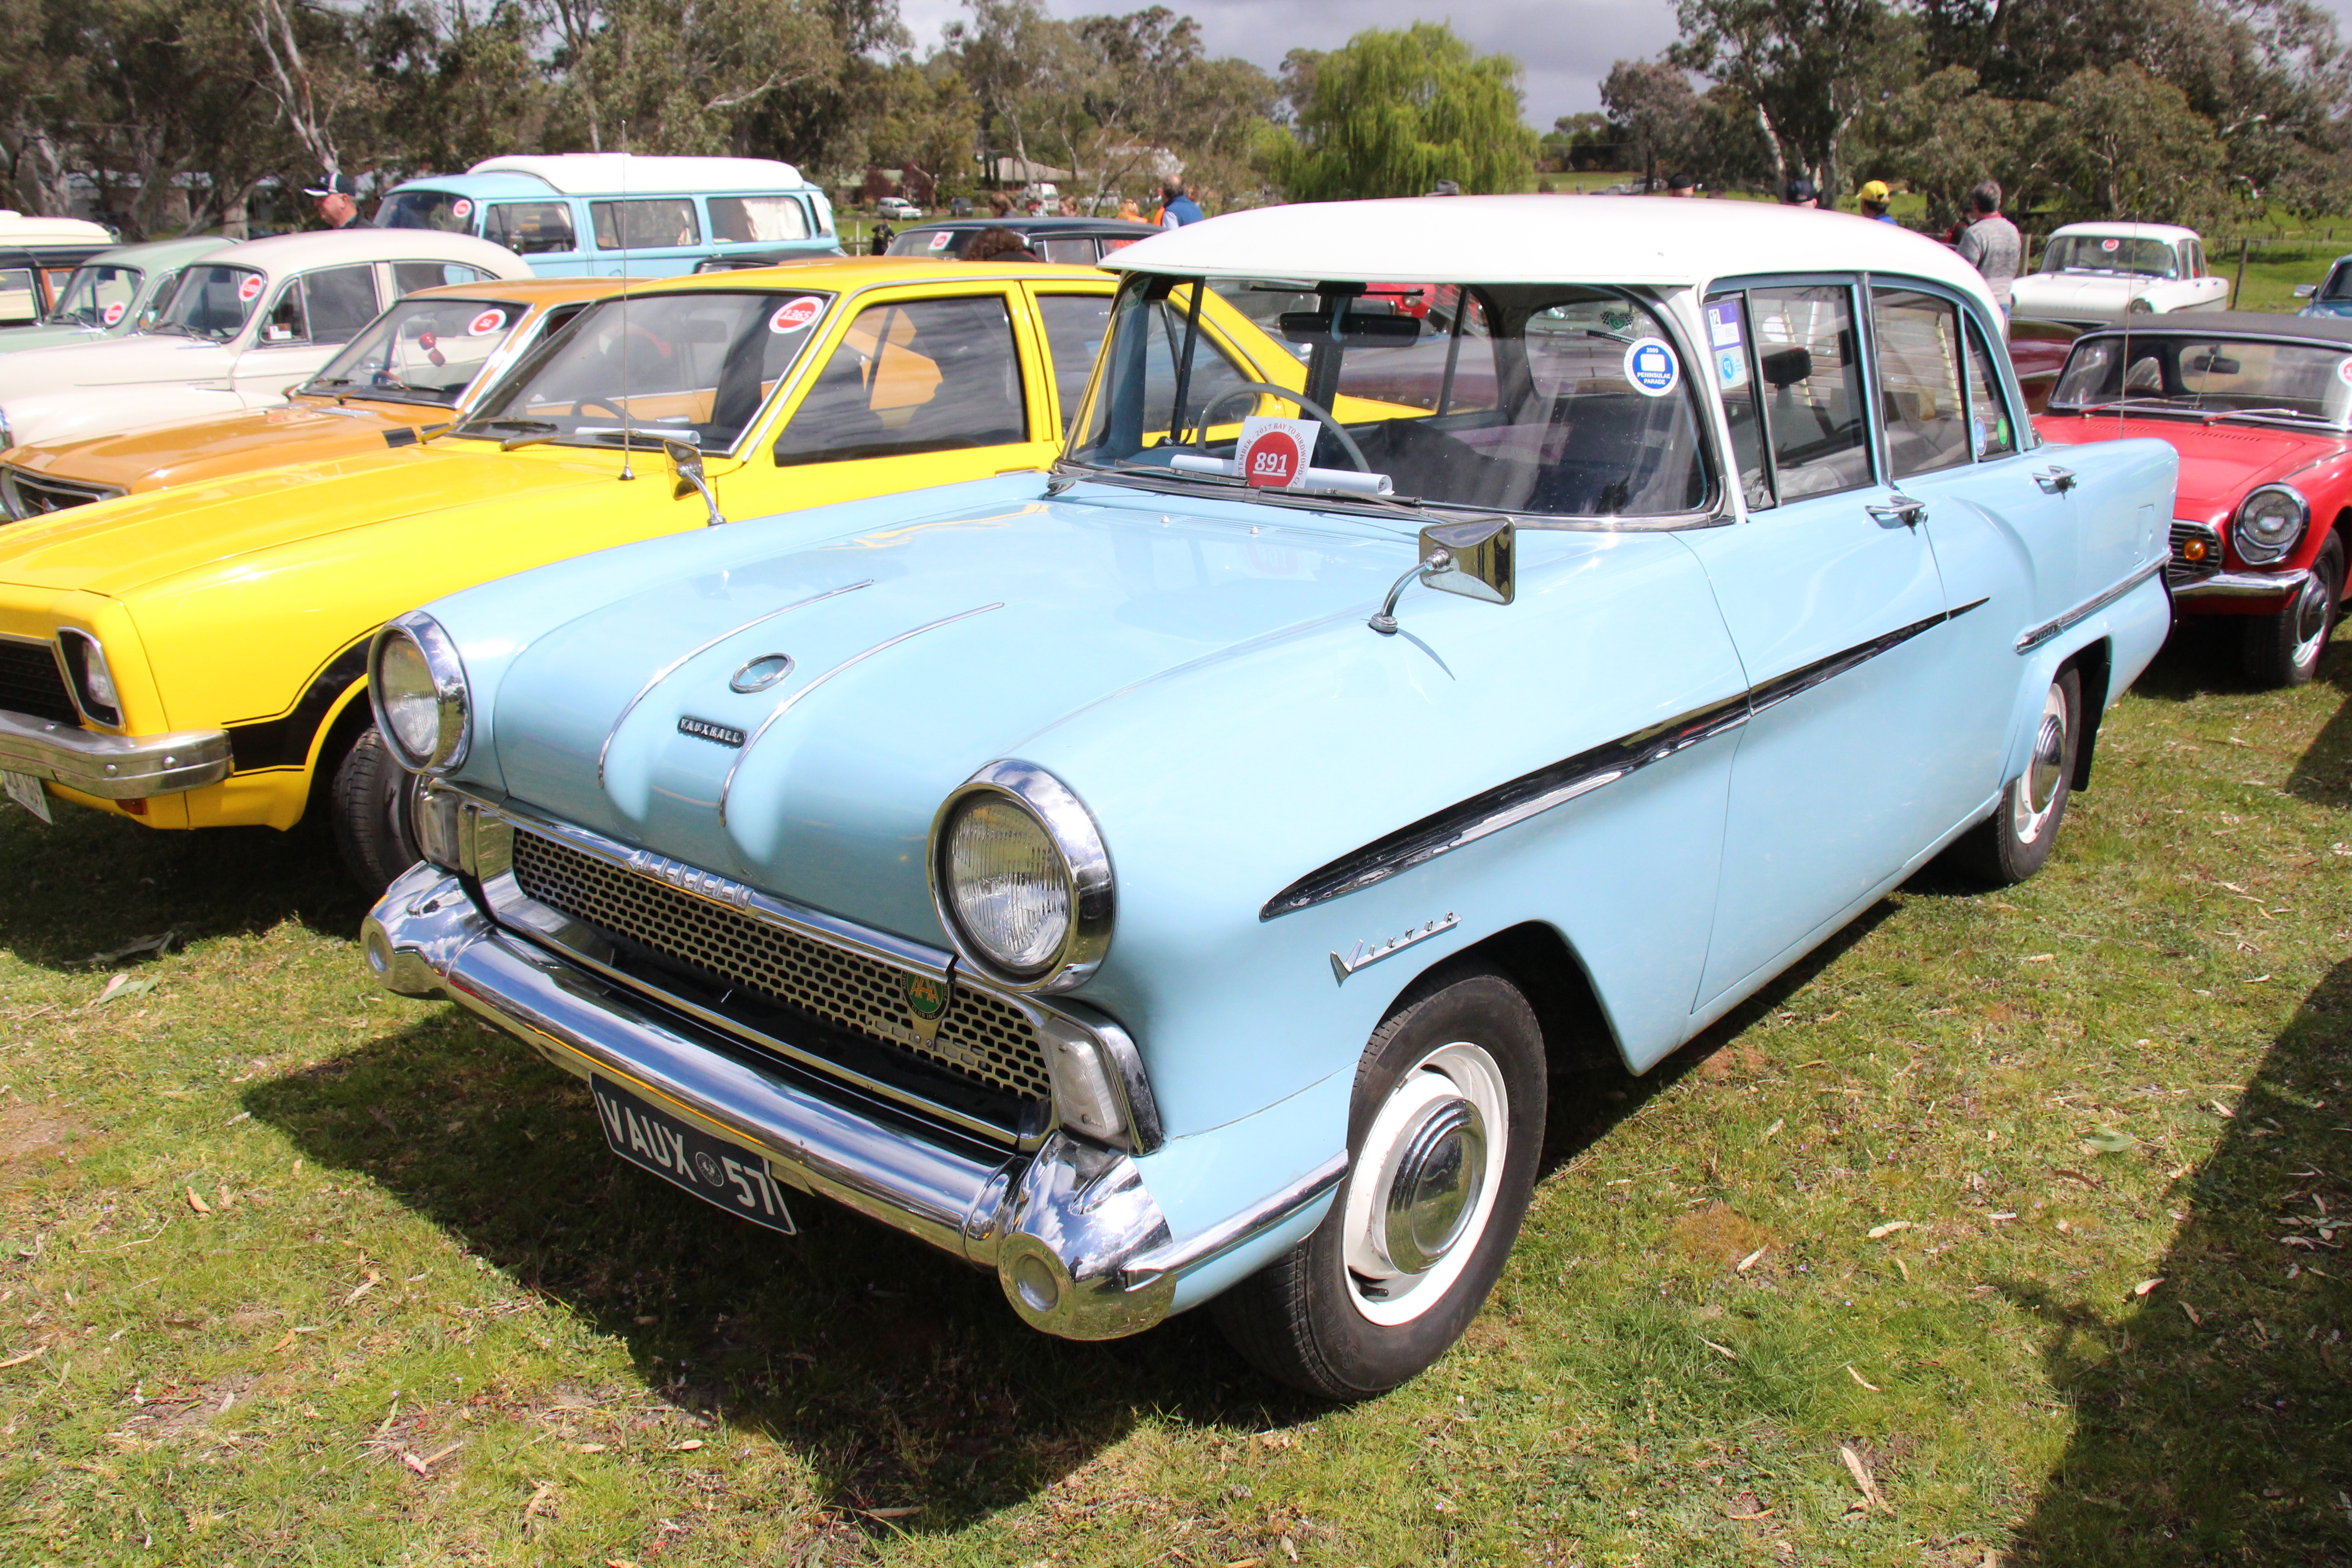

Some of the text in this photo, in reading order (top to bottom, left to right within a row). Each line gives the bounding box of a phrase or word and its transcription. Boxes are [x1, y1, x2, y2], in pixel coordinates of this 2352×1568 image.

[782, 309, 812, 319] 1365
[1710, 310, 1720, 325] 12
[1630, 339, 1650, 356] HISTORIC
[1651, 339, 1675, 359] MOTORING
[1627, 366, 1651, 394] FEDERATION
[1238, 439, 1252, 476] PTEMBER
[1255, 424, 1272, 437] 2017
[1288, 426, 1296, 434] TO
[1294, 432, 1307, 475] BIRDWOOD
[1254, 451, 1288, 473] 891
[681, 718, 741, 743] VAUXHALL
[911, 1004, 926, 1018] CLUB
[598, 1091, 698, 1183] VAUX
[721, 1155, 775, 1216] 57
